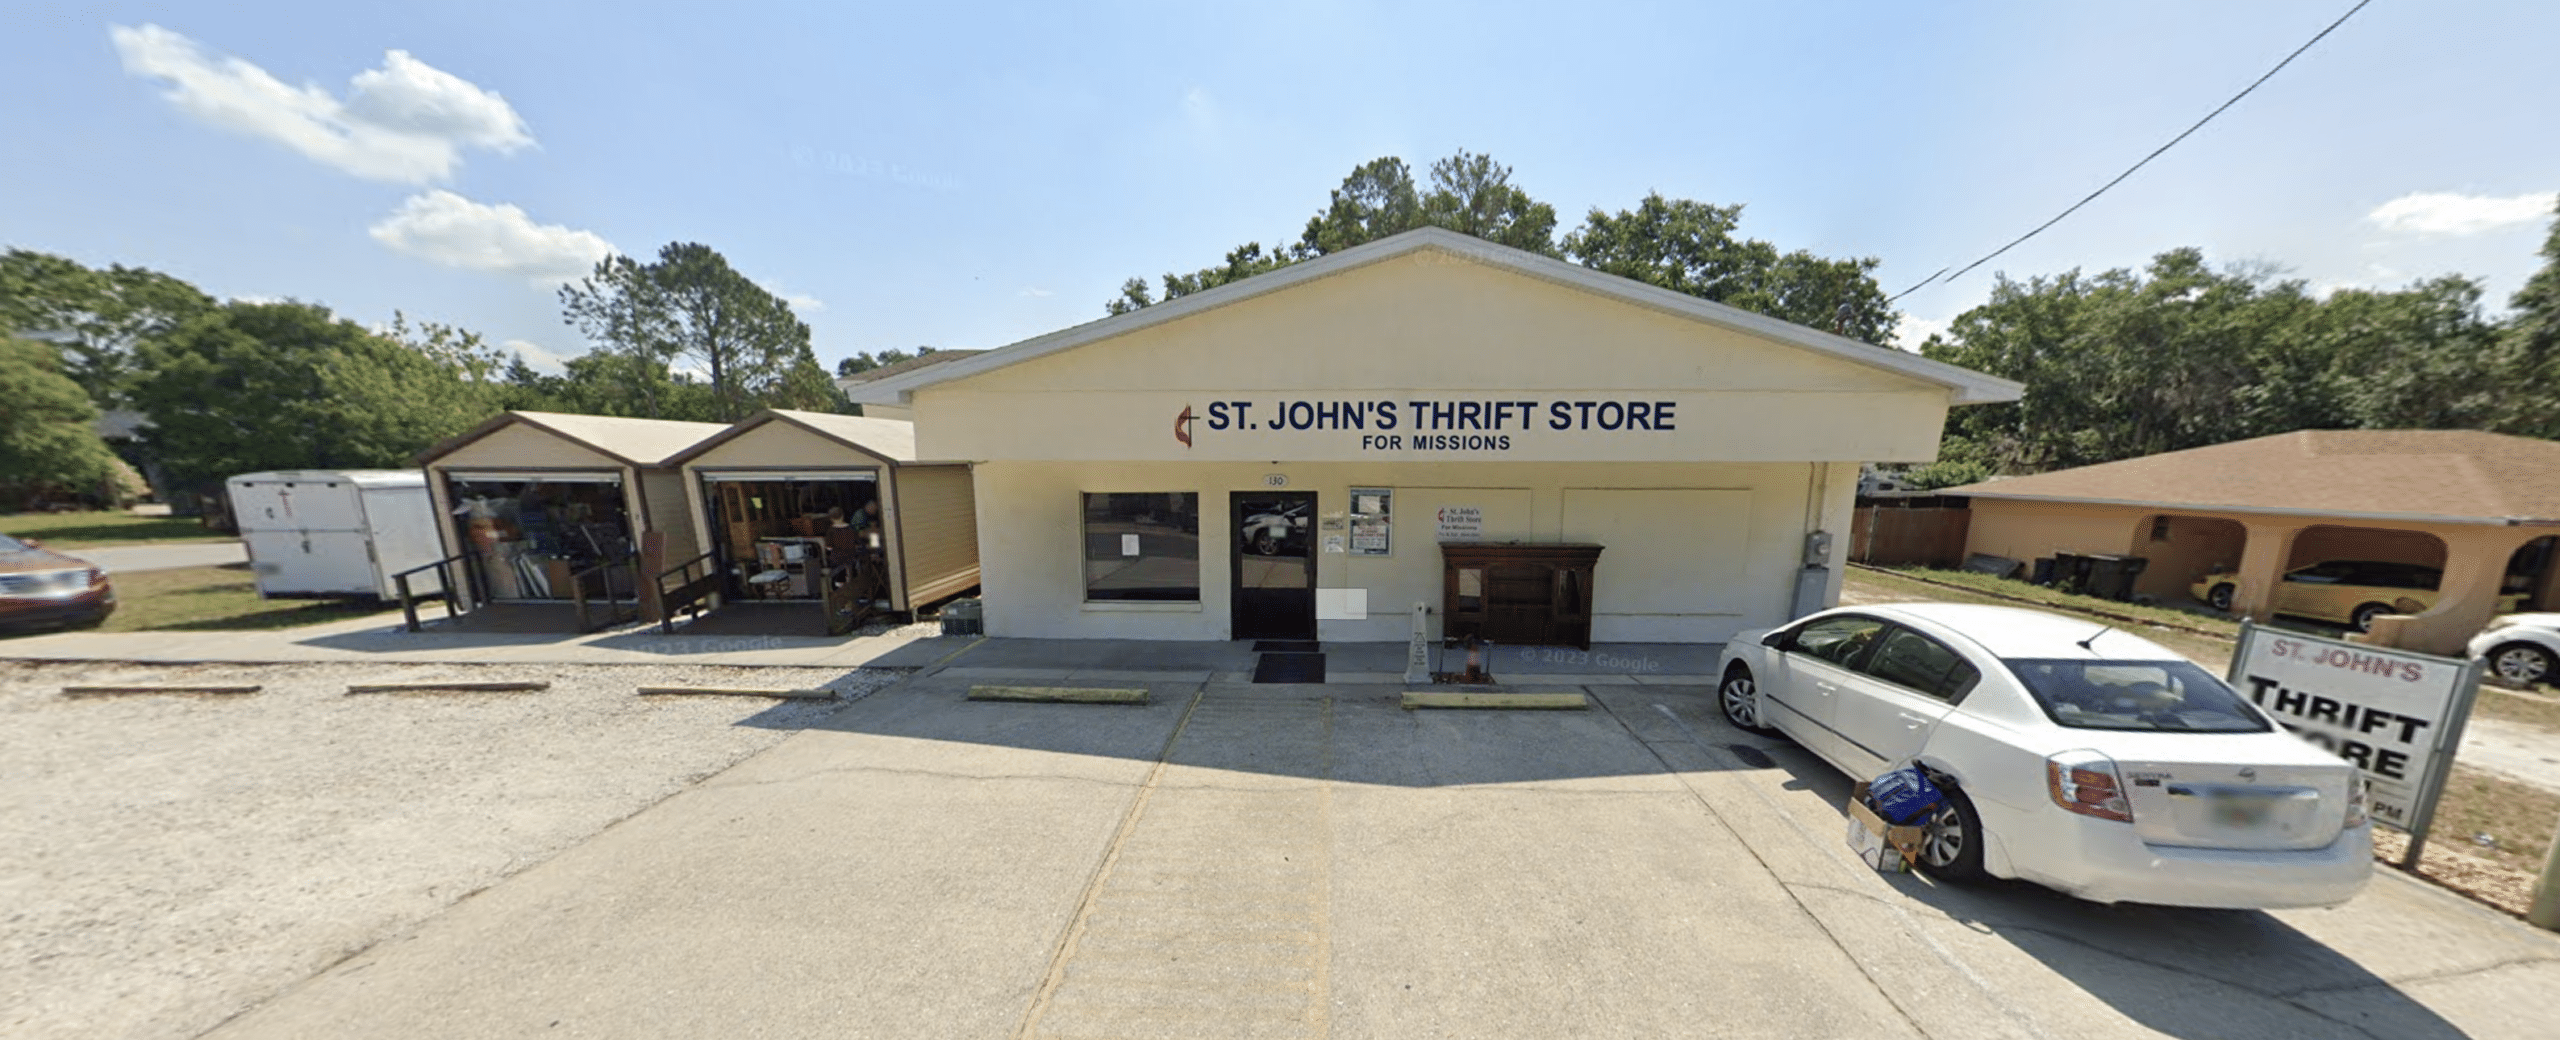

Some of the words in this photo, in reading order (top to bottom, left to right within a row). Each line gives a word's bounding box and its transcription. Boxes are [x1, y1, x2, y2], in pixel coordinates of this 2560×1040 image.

[1207, 401, 1257, 431] ST.
[1268, 400, 1398, 431] JOHN'S
[1408, 401, 1539, 430] THRIFT
[1548, 400, 1677, 431] STORE
[1362, 435, 1402, 451] FOR
[1413, 434, 1511, 451] MISSIONS
[2314, 648, 2423, 683] JOHN'S
[2247, 674, 2430, 745] THRIFT
